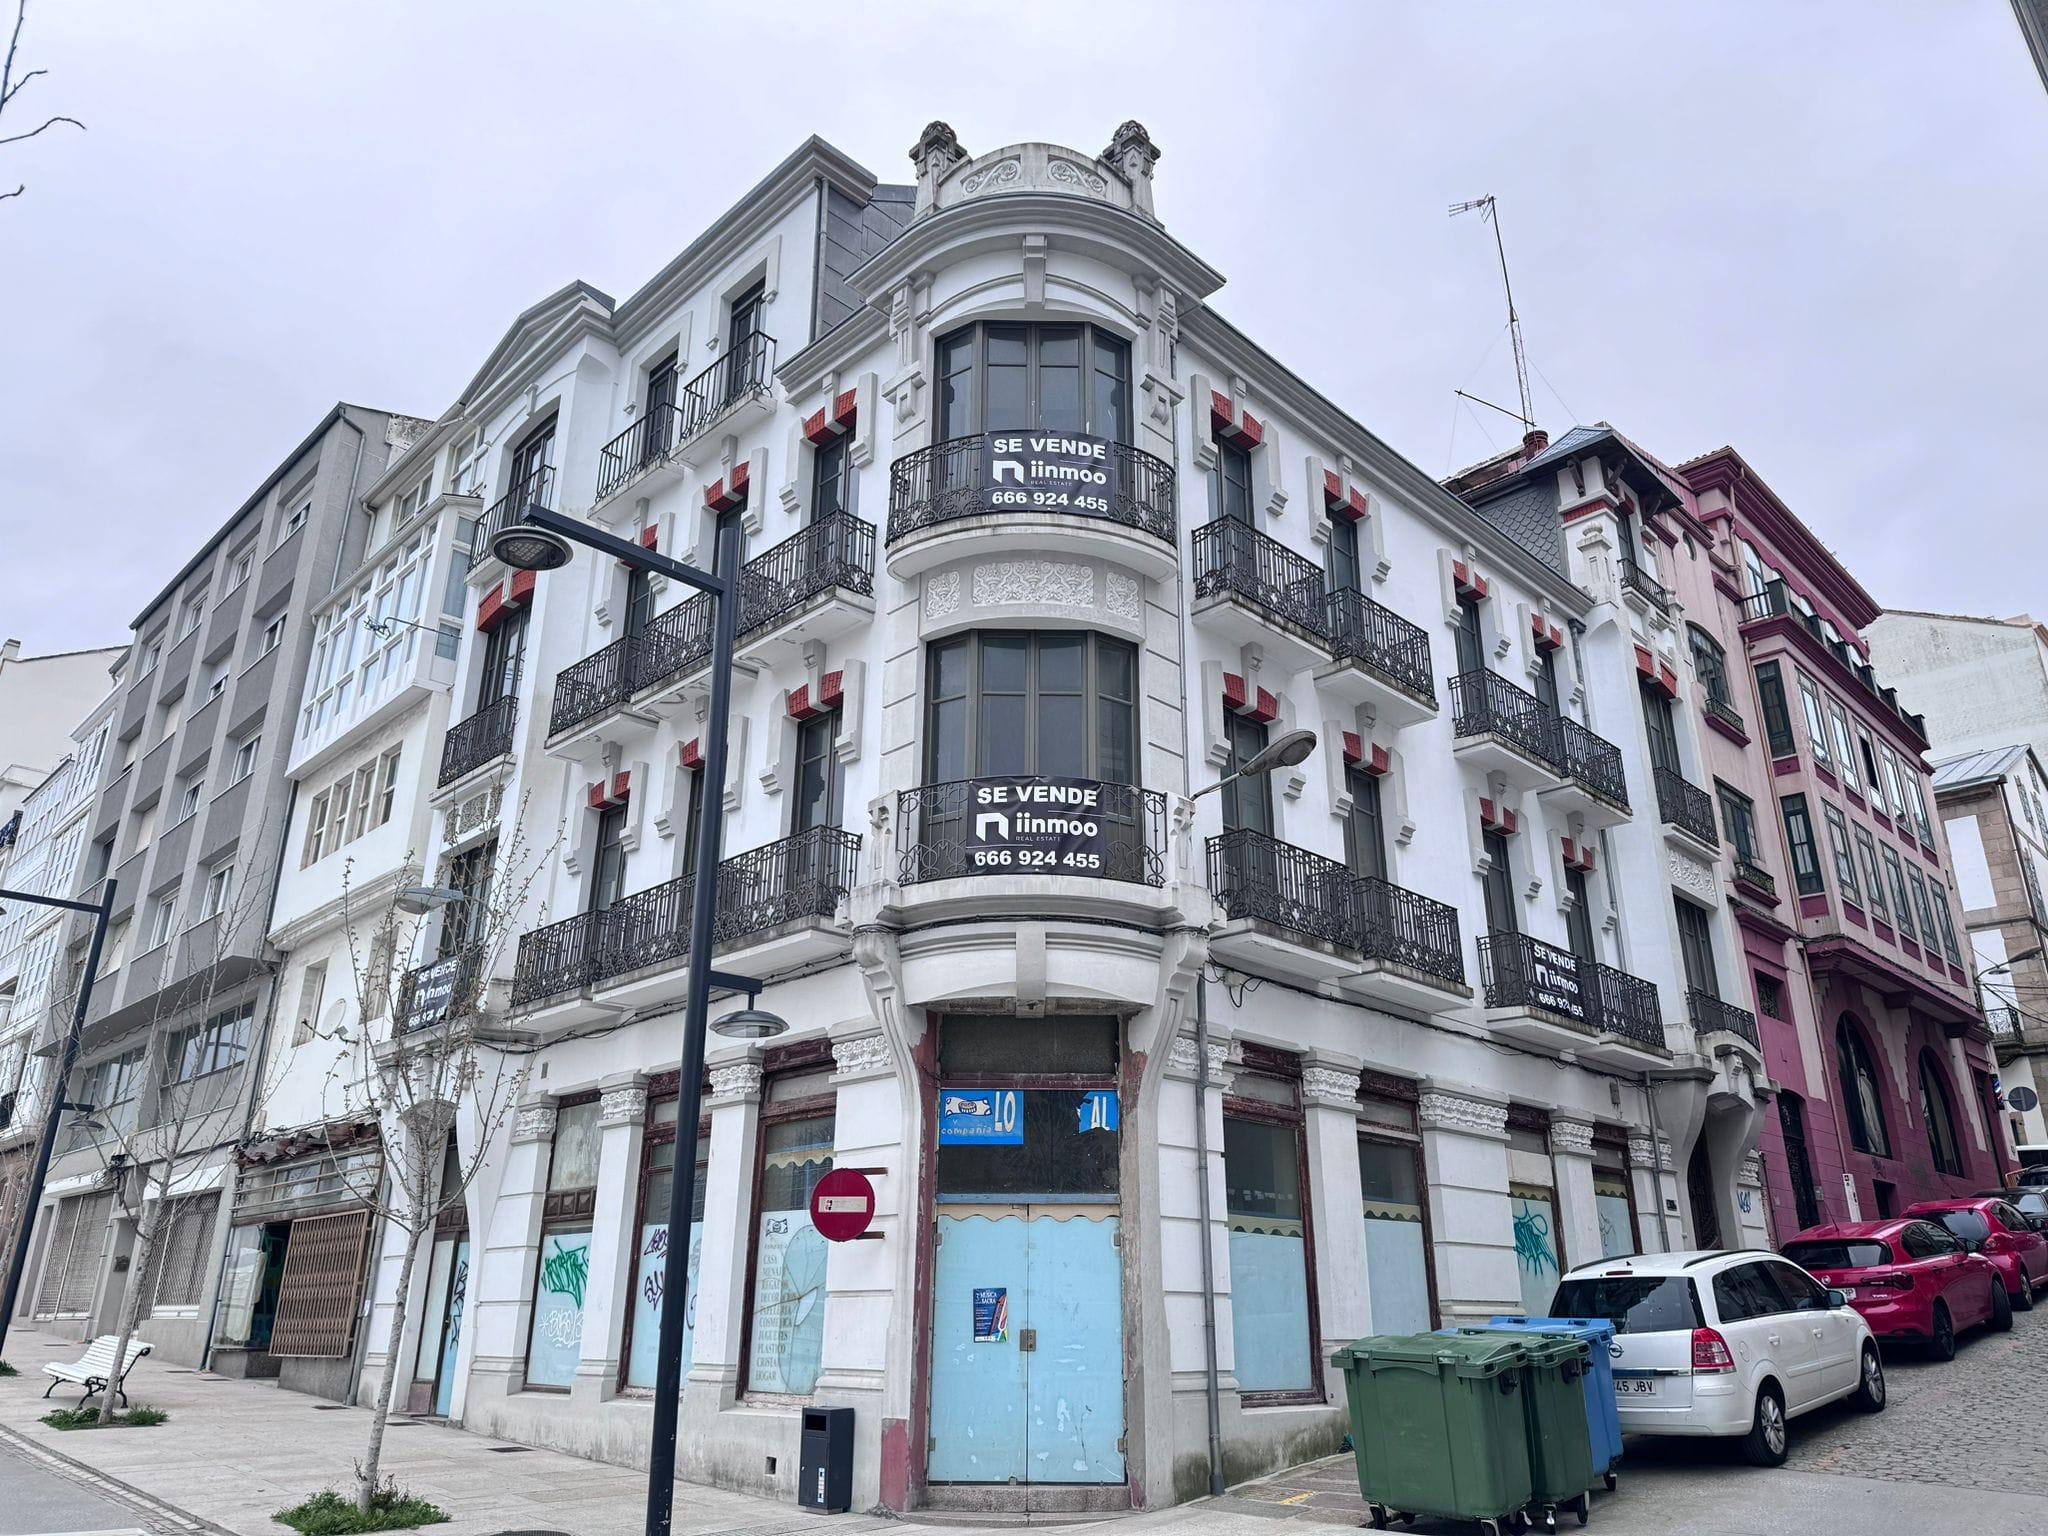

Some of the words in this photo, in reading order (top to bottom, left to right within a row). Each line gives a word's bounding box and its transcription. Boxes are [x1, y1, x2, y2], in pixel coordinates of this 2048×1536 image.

[993, 438, 1023, 454] SE
[1030, 438, 1106, 459] VENDE
[1030, 460, 1107, 484] iinmoo
[991, 491, 1027, 505] 666
[1033, 492, 1069, 506] 924
[1074, 495, 1108, 512] 455
[977, 786, 1008, 804] SE
[1015, 786, 1097, 807] VENDE
[1016, 812, 1098, 838] iinmoo
[974, 850, 1012, 866] 666
[1018, 850, 1057, 866] 924
[1062, 852, 1100, 869] 455
[1533, 943, 1547, 960] SE
[1547, 950, 1576, 973] VENDE
[418, 970, 430, 984] SE
[430, 960, 457, 979] VENDE
[1633, 1380, 1653, 1392] JBV
